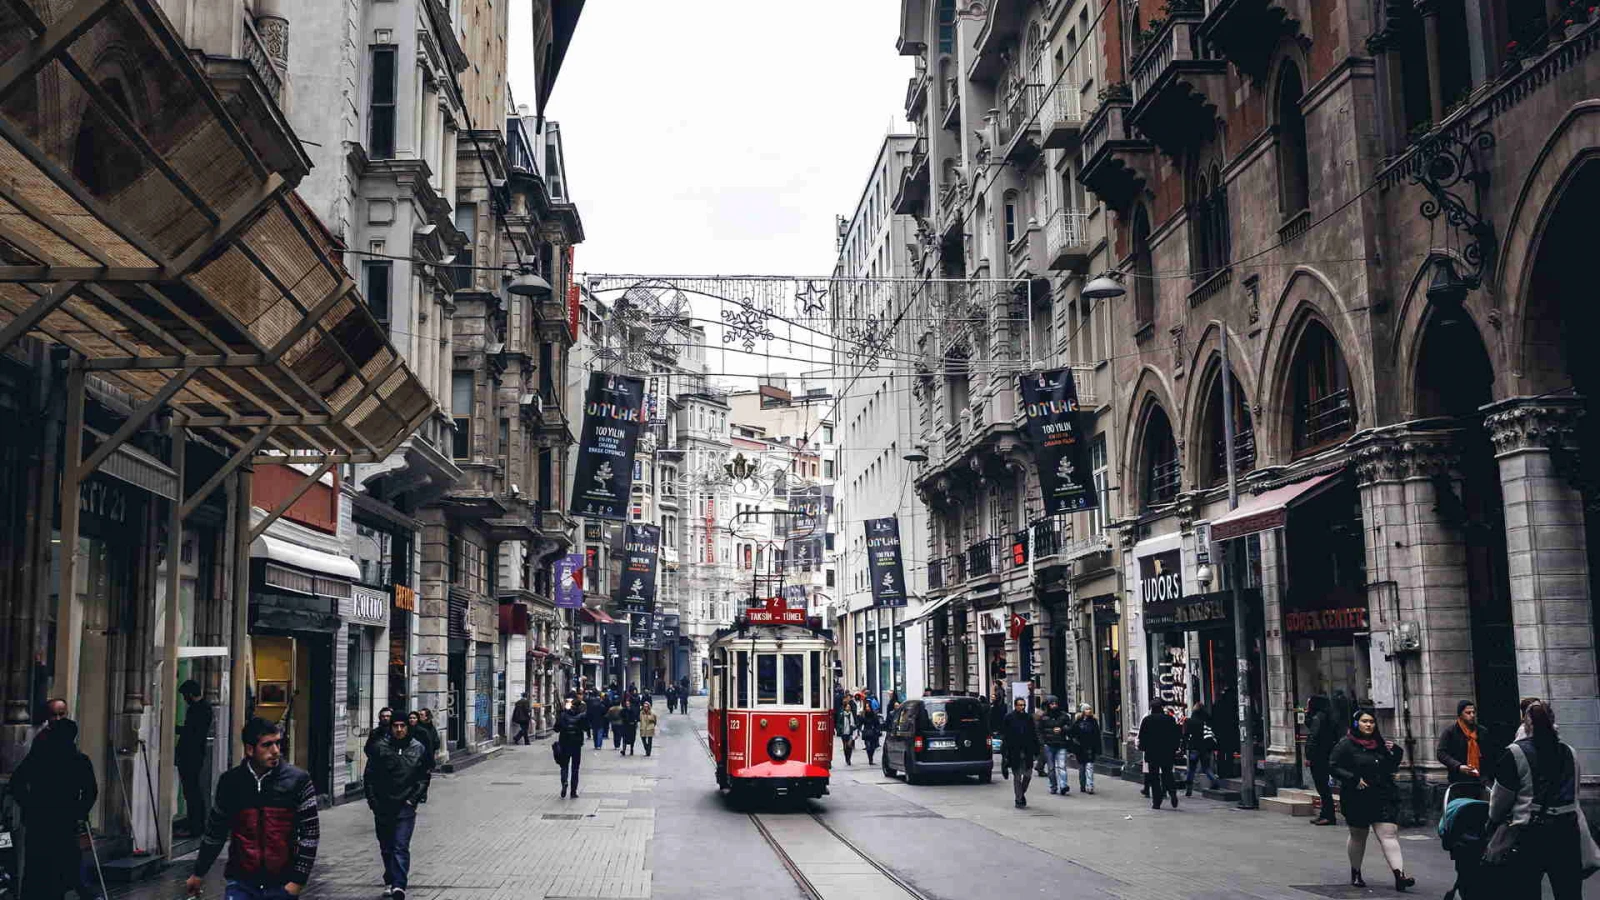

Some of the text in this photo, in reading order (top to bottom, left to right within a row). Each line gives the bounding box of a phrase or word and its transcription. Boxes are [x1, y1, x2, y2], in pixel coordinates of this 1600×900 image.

[595, 426, 625, 439] 100 YILIN
[1041, 421, 1071, 434] 100 YILIN
[1139, 573, 1179, 603] TUDORS
[773, 597, 779, 607] 2
